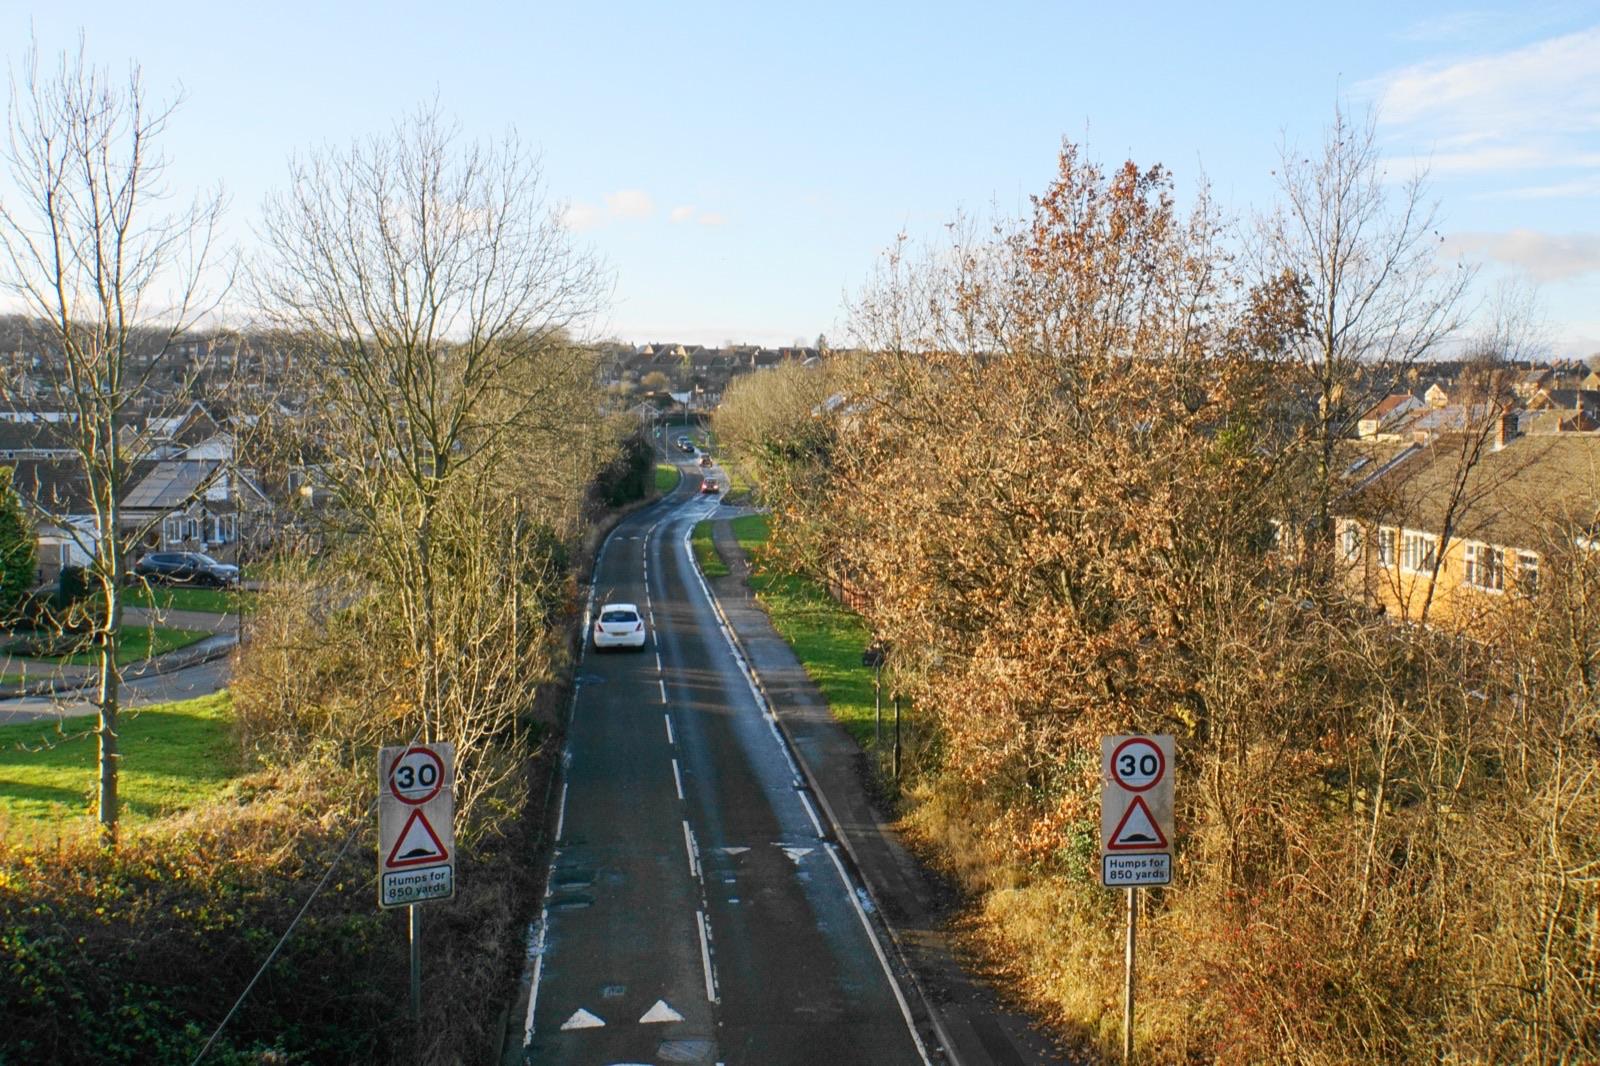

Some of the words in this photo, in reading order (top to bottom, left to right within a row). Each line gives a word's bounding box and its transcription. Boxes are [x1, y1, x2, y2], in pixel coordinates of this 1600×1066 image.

[1119, 754, 1158, 776] 30
[398, 764, 437, 789] 30
[1110, 859, 1147, 870] Humps
[1149, 858, 1165, 867] for
[388, 874, 427, 887] Humps
[430, 871, 446, 882] for
[1110, 870, 1133, 880] 850
[1135, 868, 1164, 880] yards
[389, 887, 413, 899] 850
[416, 883, 446, 896] yards
